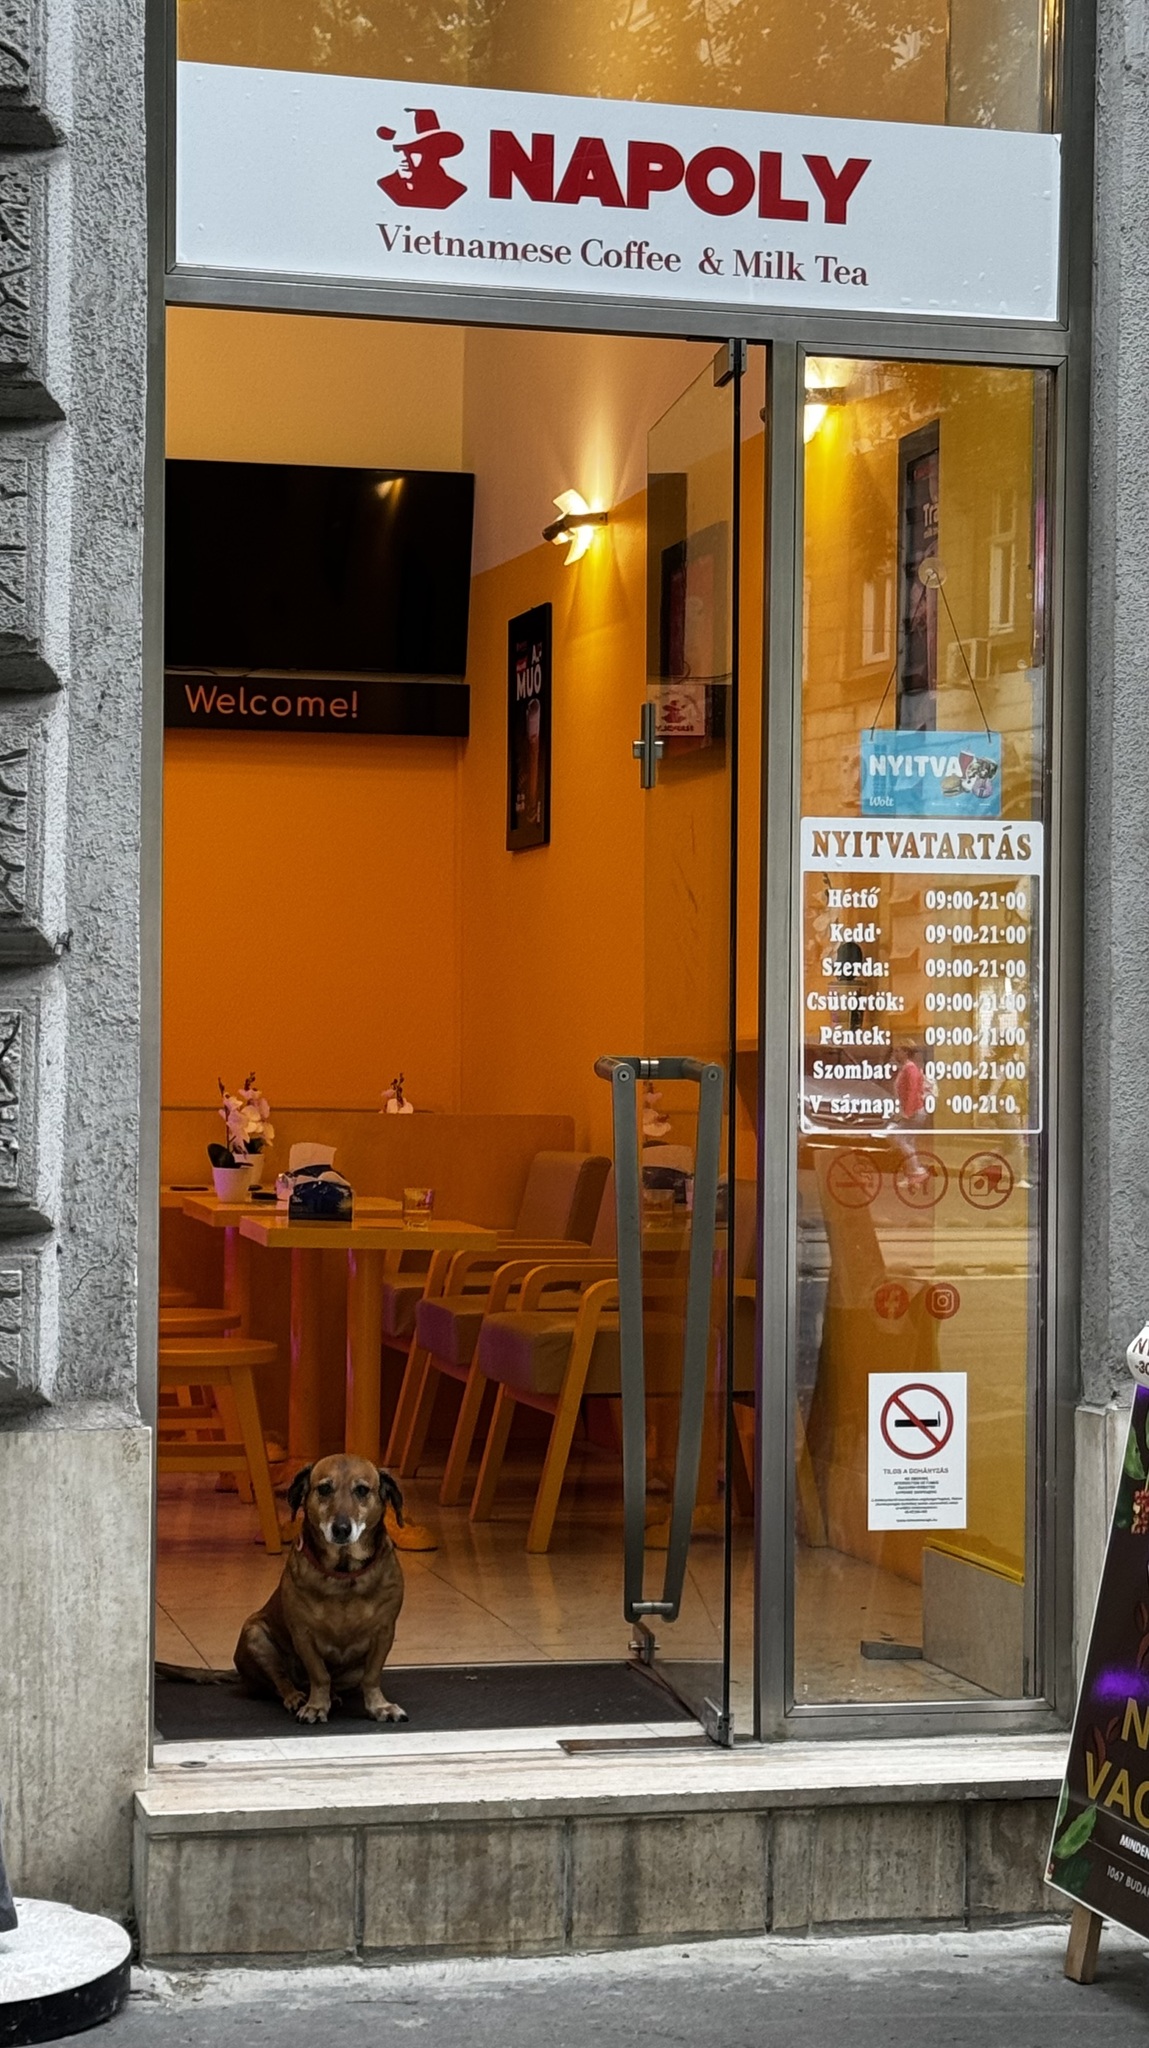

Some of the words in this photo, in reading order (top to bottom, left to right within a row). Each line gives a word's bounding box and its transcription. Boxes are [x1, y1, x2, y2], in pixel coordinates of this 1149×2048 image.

[489, 129, 872, 225] NAPOLY
[376, 223, 571, 265] Vietnamese
[580, 238, 682, 273] Coffee
[698, 247, 724, 276] &
[733, 250, 806, 283] Milk
[815, 256, 870, 287] Tea
[185, 684, 359, 718] Welcome!
[869, 755, 963, 777] NYITVA
[812, 825, 1032, 861] NYITVATARTÁS
[827, 886, 881, 909] Hétfő
[822, 957, 890, 977] Szerda:
[806, 991, 905, 1011] Csütörtök:
[820, 1025, 891, 1045] Péntek:
[809, 1093, 900, 1119] Vsárnap:
[1107, 1865, 1125, 1883] 1067
